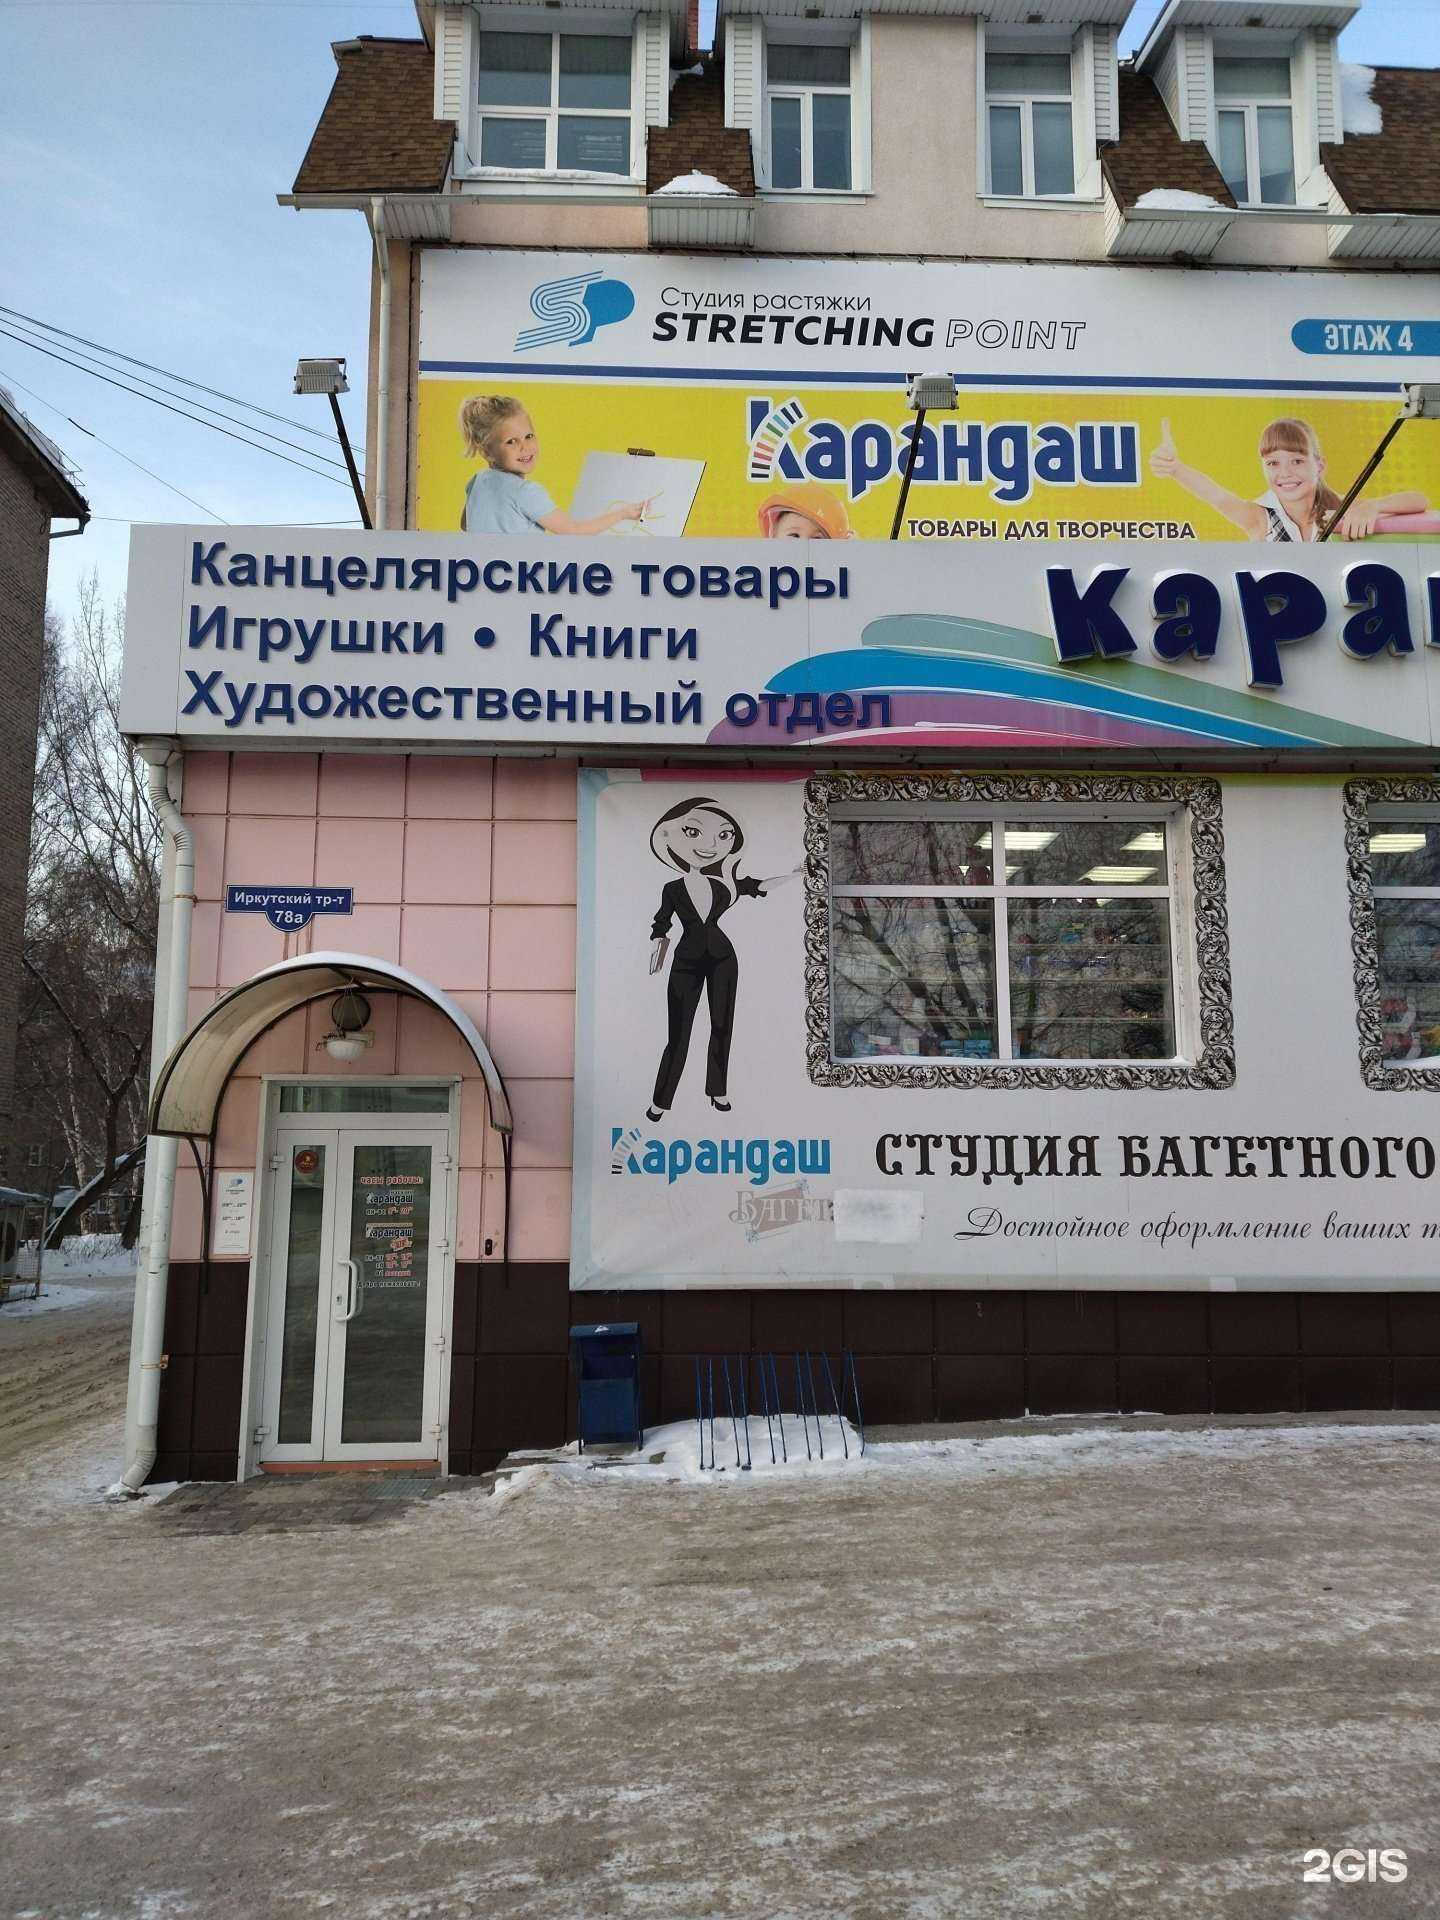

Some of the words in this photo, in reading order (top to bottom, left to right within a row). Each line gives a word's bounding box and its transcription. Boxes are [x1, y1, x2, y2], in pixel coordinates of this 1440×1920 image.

[660, 286, 744, 311] Студия
[753, 291, 871, 313] растяжки
[652, 311, 935, 348] STRETCHING
[945, 318, 1087, 350] POINT
[1324, 323, 1392, 351] ЭТАЖ
[1397, 325, 1414, 352] 4
[748, 398, 1139, 502] Карандаш
[907, 519, 997, 538] ТОВАРЫ
[1004, 520, 1049, 540] ДЛЯ
[1056, 520, 1196, 539] ТВОРЧЕСТВА
[190, 541, 613, 604] Канцелярские
[630, 562, 850, 608] товары
[187, 604, 445, 662] Игрушки
[529, 613, 699, 660] Книги
[180, 669, 703, 728] Художественный
[724, 686, 892, 729] отдел
[234, 891, 311, 906] Иркутский
[315, 895, 345, 907] тр-т
[274, 910, 303, 924] 78а
[611, 1127, 831, 1186] Карандаш
[875, 1133, 1102, 1186] СТУДИЯ
[1117, 1135, 1436, 1179] БАГЕТНОГО
[953, 1206, 1130, 1241] Достойное
[1140, 1212, 1312, 1249] оформление
[1323, 1210, 1411, 1239] ваших
